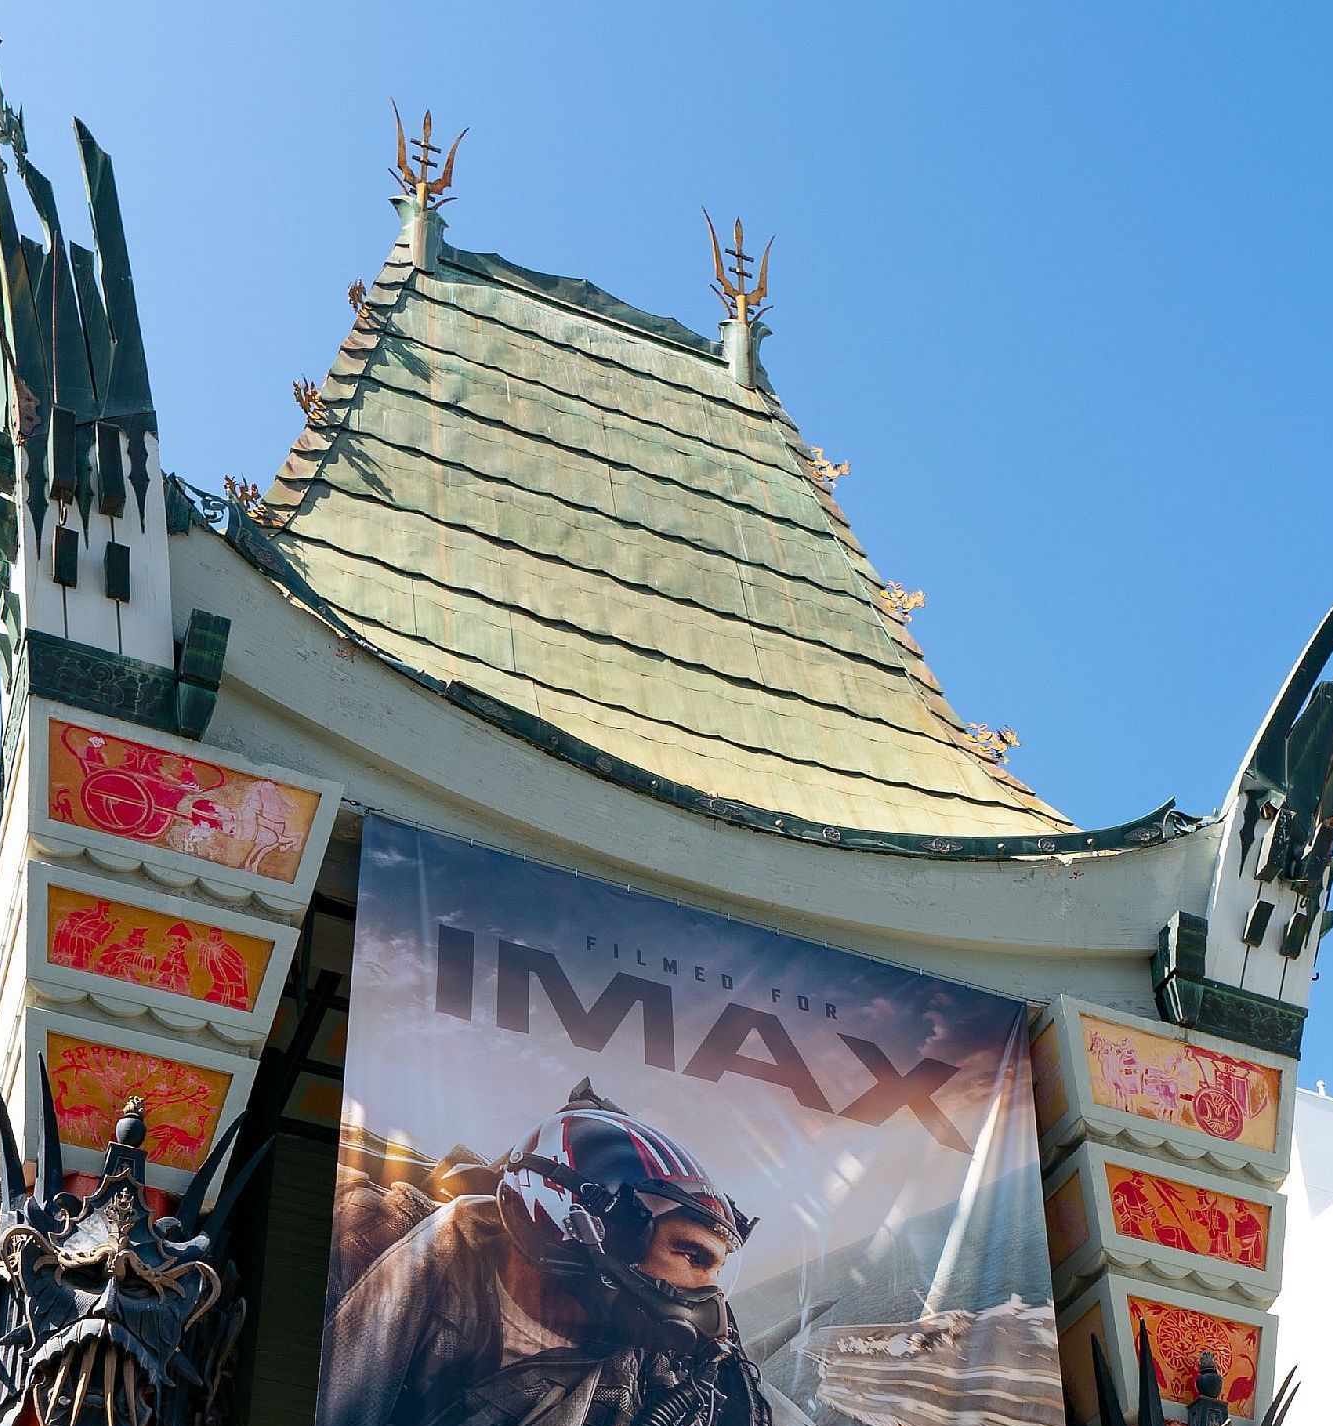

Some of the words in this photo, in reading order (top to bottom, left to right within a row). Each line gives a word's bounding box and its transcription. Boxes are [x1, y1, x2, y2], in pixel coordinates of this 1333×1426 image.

[434, 923, 975, 1156] IMAX
[585, 934, 735, 991] FILMED
[771, 987, 838, 1021] FOR
